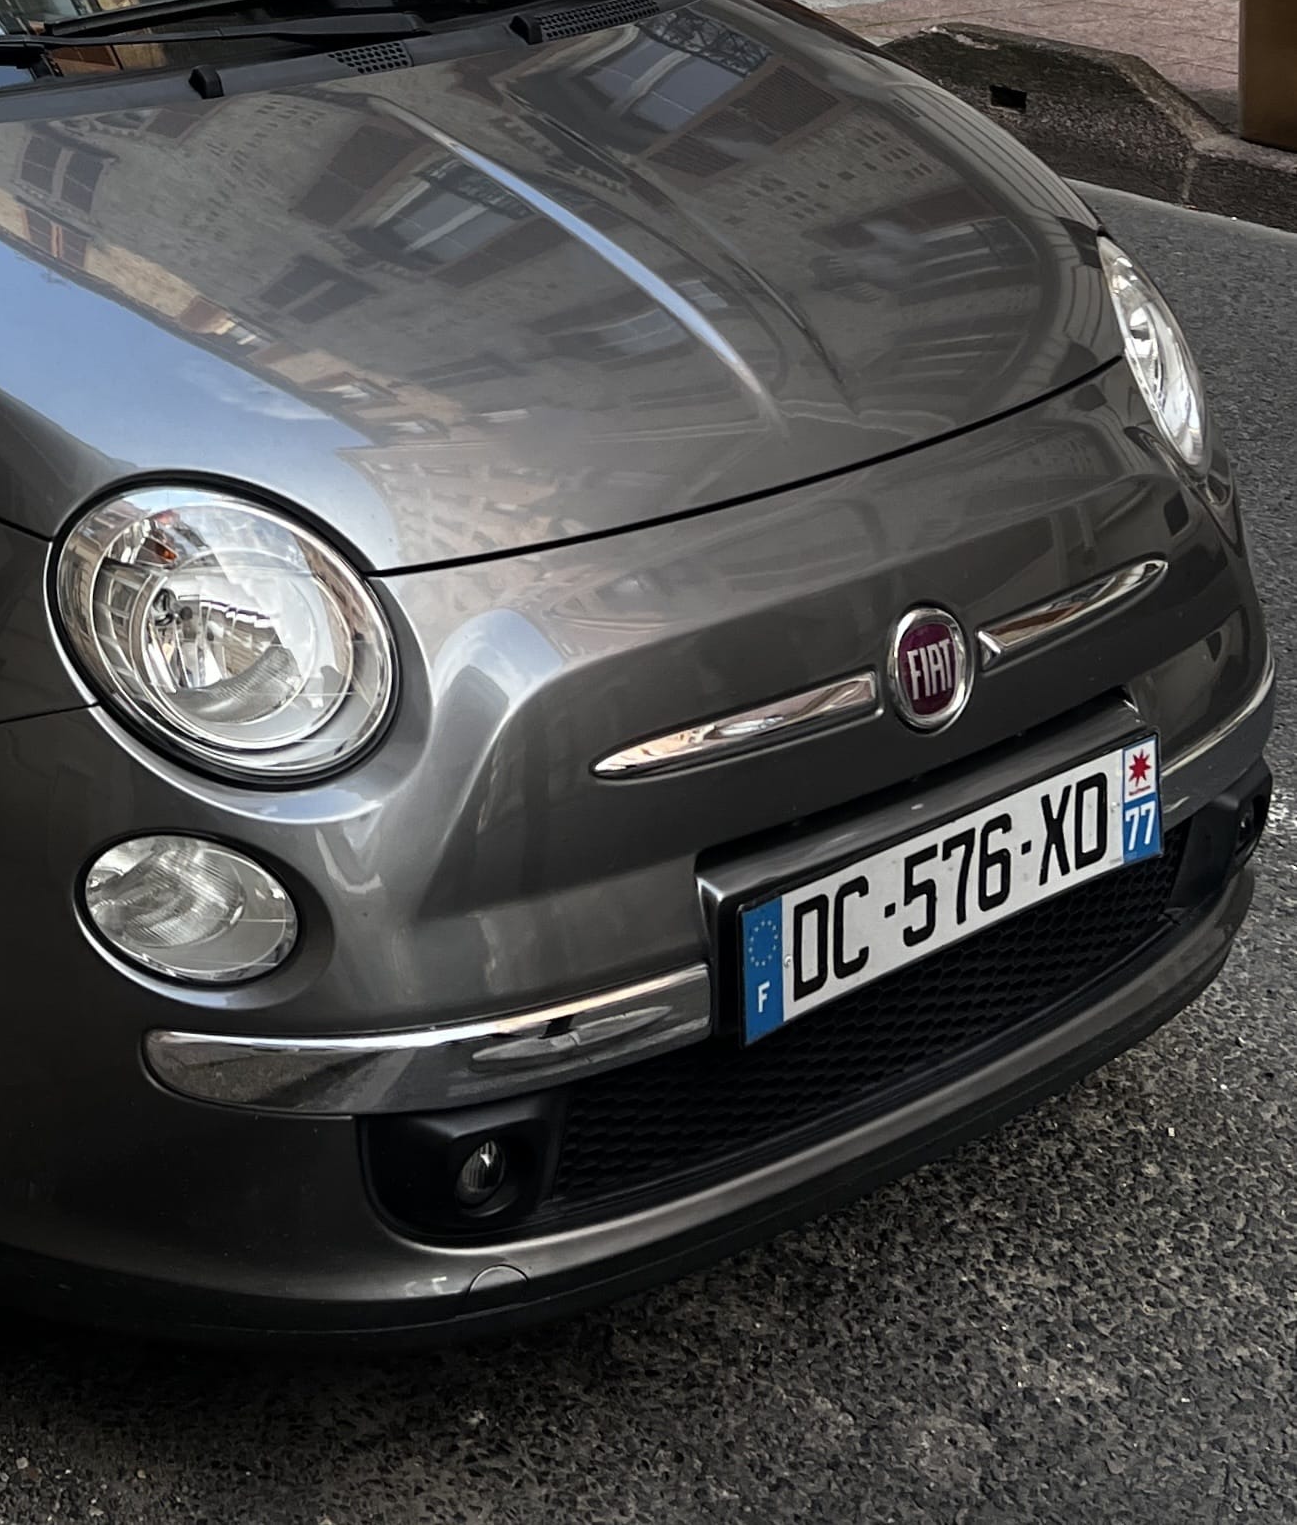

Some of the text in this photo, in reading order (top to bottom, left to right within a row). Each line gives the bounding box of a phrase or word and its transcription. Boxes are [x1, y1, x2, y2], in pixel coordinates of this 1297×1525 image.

[907, 638, 952, 700] FIAT
[1125, 800, 1156, 851] 77
[757, 981, 771, 1013] F
